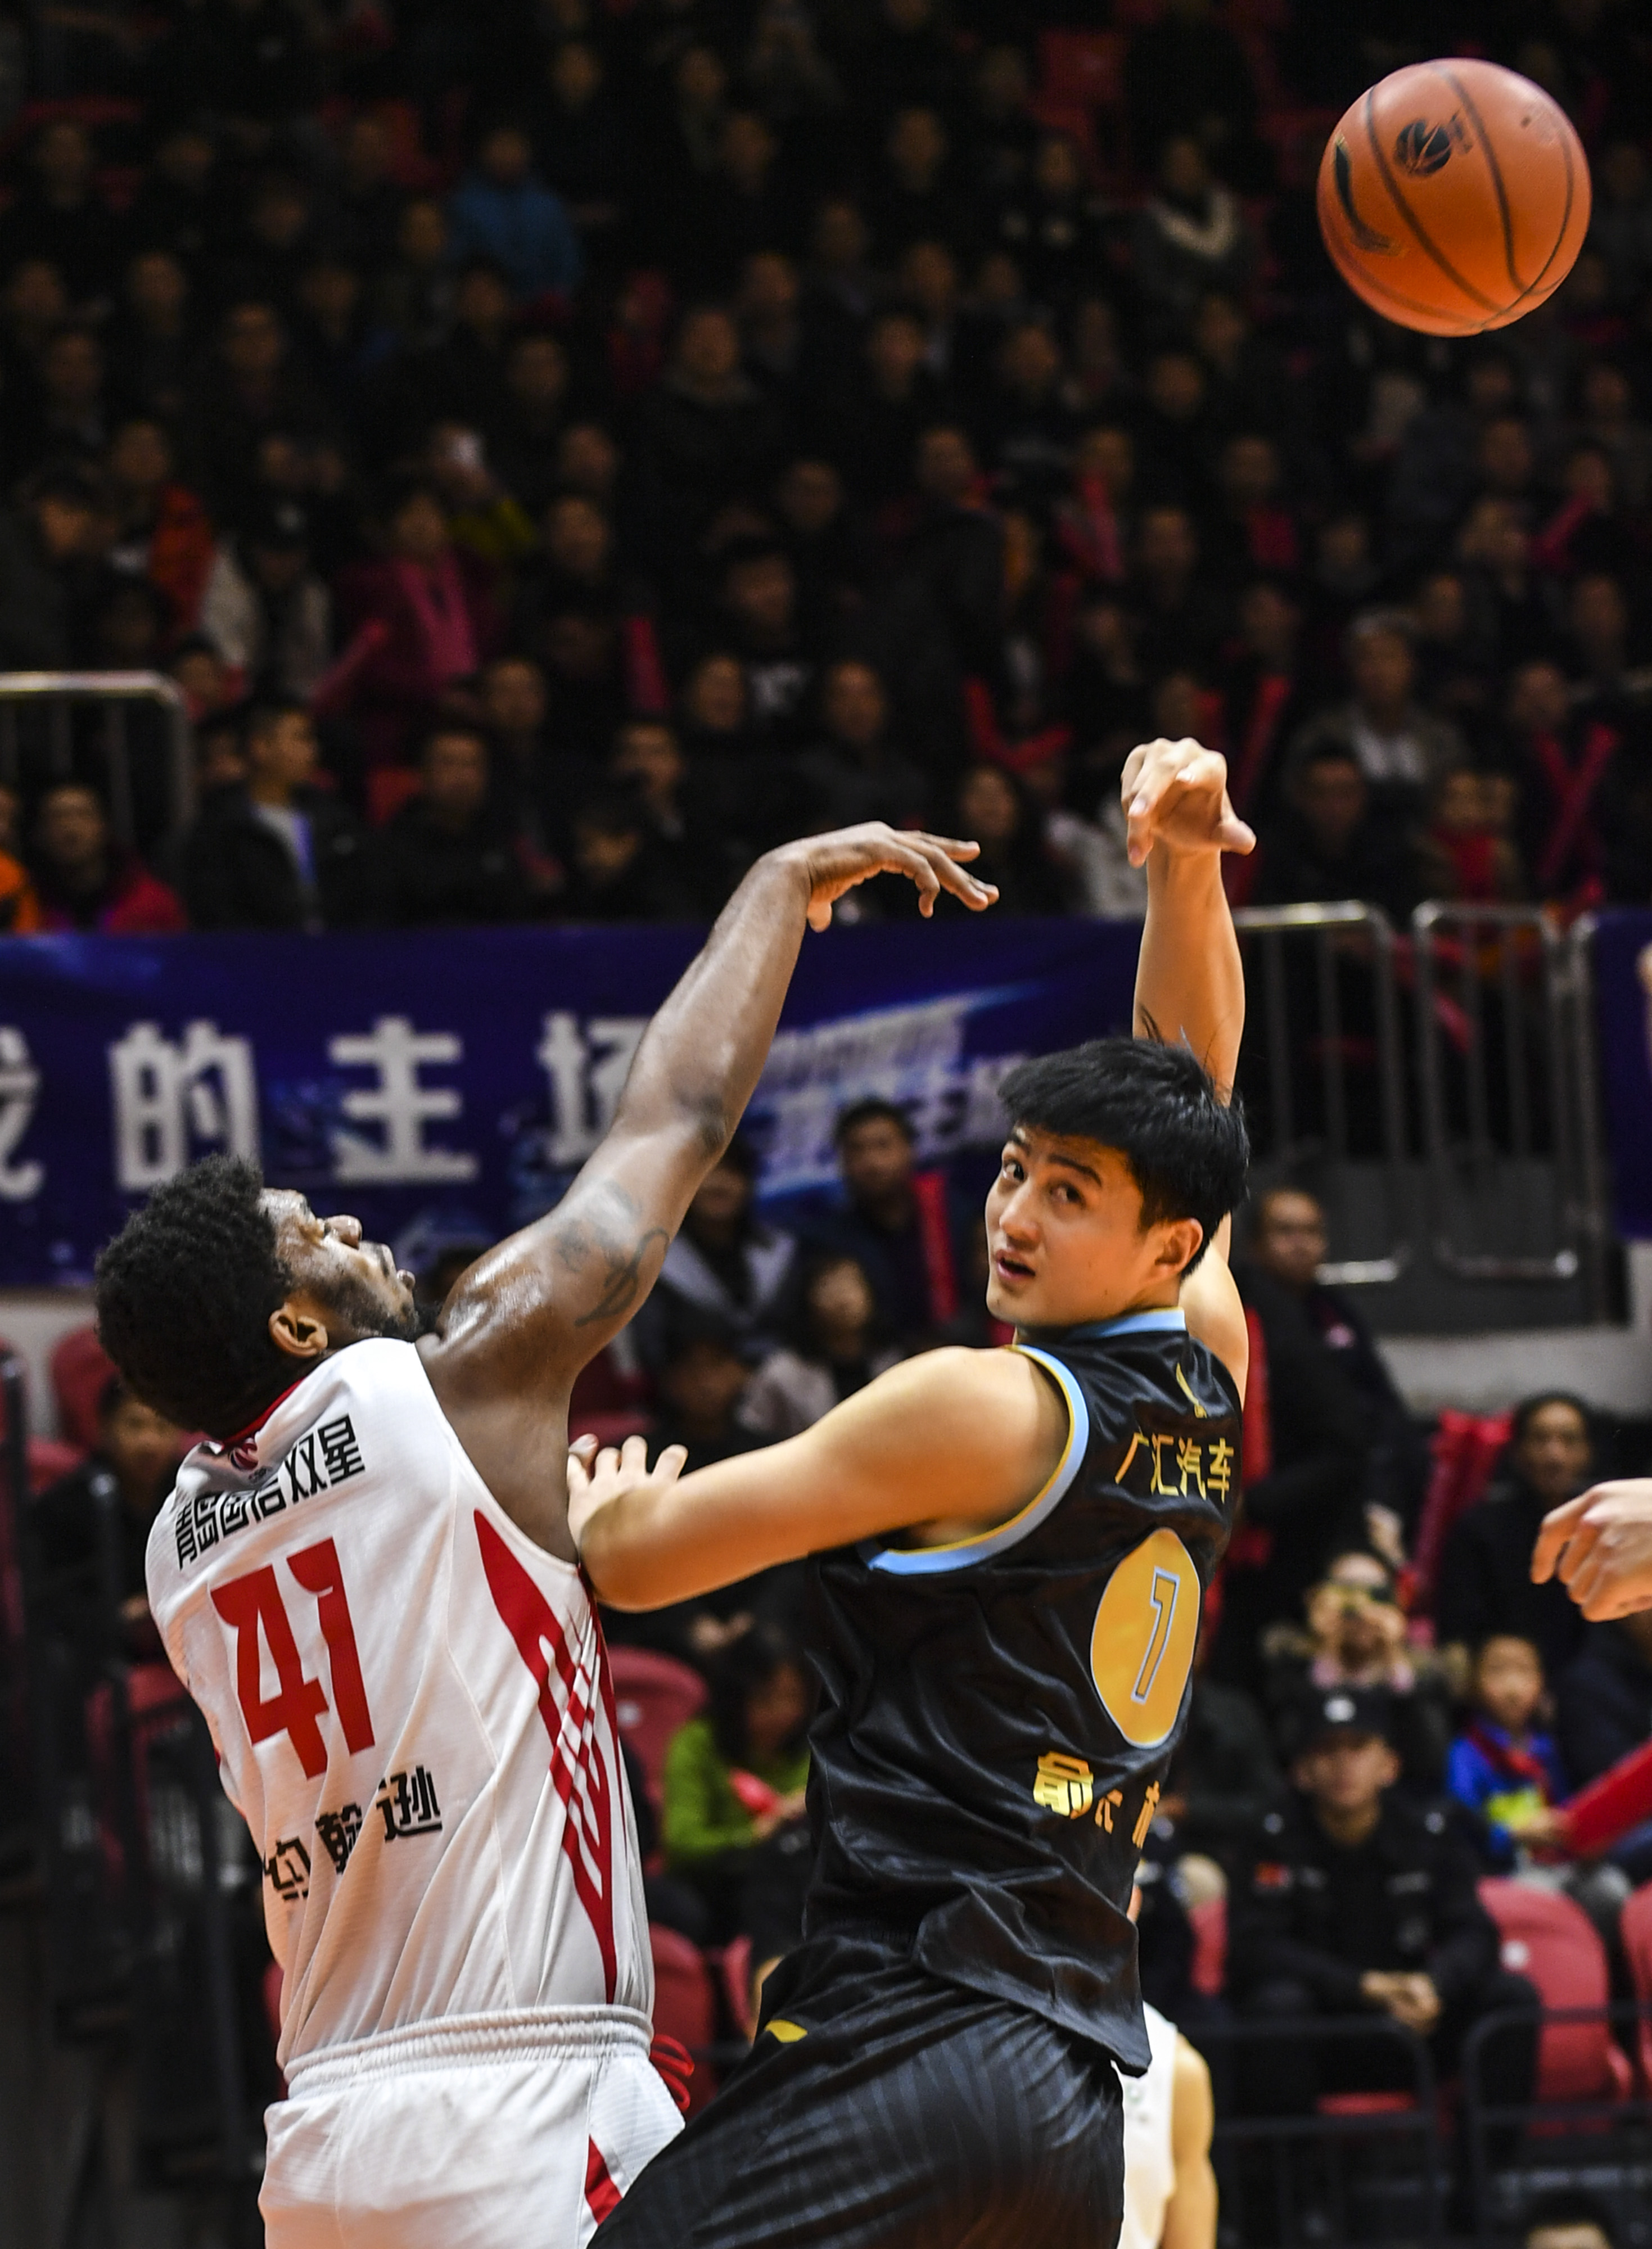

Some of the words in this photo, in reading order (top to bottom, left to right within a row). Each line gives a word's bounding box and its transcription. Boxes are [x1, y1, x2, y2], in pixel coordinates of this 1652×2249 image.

[1115, 1432, 1234, 1503] 广汇汽车
[209, 1536, 376, 1780] 41
